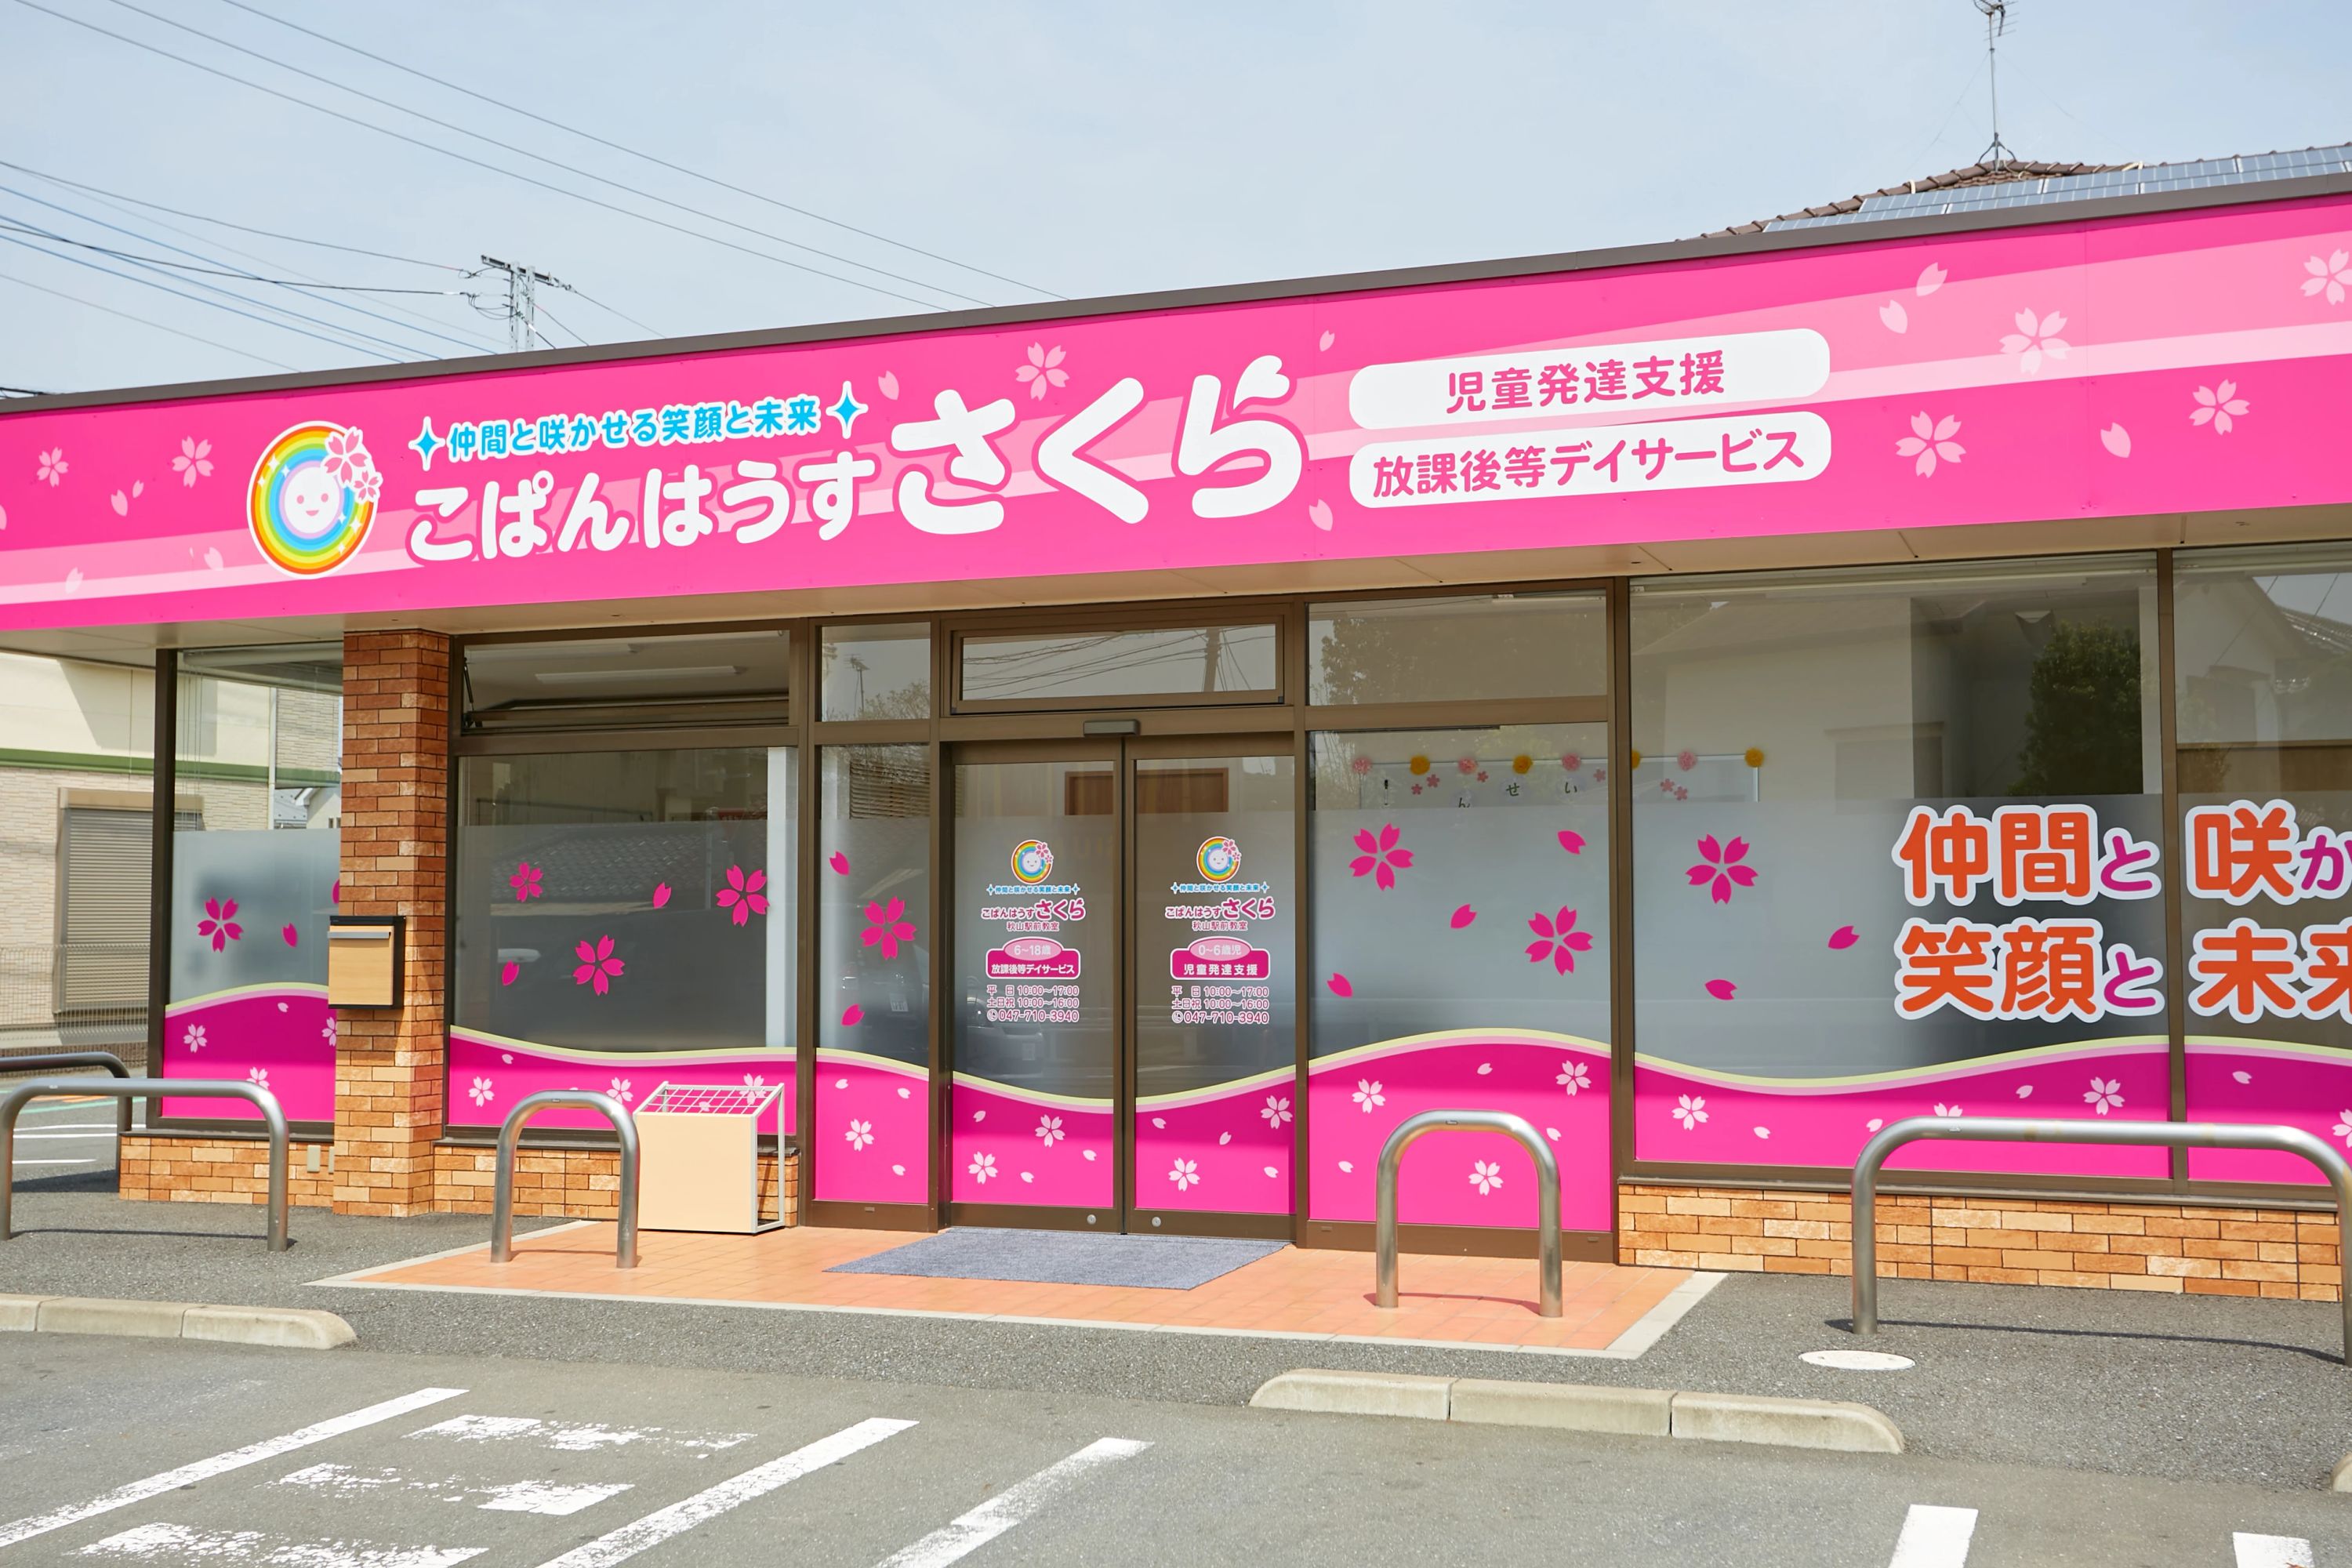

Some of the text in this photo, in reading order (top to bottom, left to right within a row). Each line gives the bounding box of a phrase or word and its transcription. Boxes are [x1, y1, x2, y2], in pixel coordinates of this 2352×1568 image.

[1446, 350, 1725, 414] 児童発達支援
[448, 396, 821, 461] 仲間と咲かせる笑顔と未来
[1372, 428, 1805, 498] 放課後等デイサービス
[991, 964, 1075, 975] 放課後等デイサービス
[1183, 964, 1258, 975] 児童発達支援
[998, 1010, 1079, 1022] 047-710-3940
[1184, 1012, 1269, 1024] 047-710-3940
